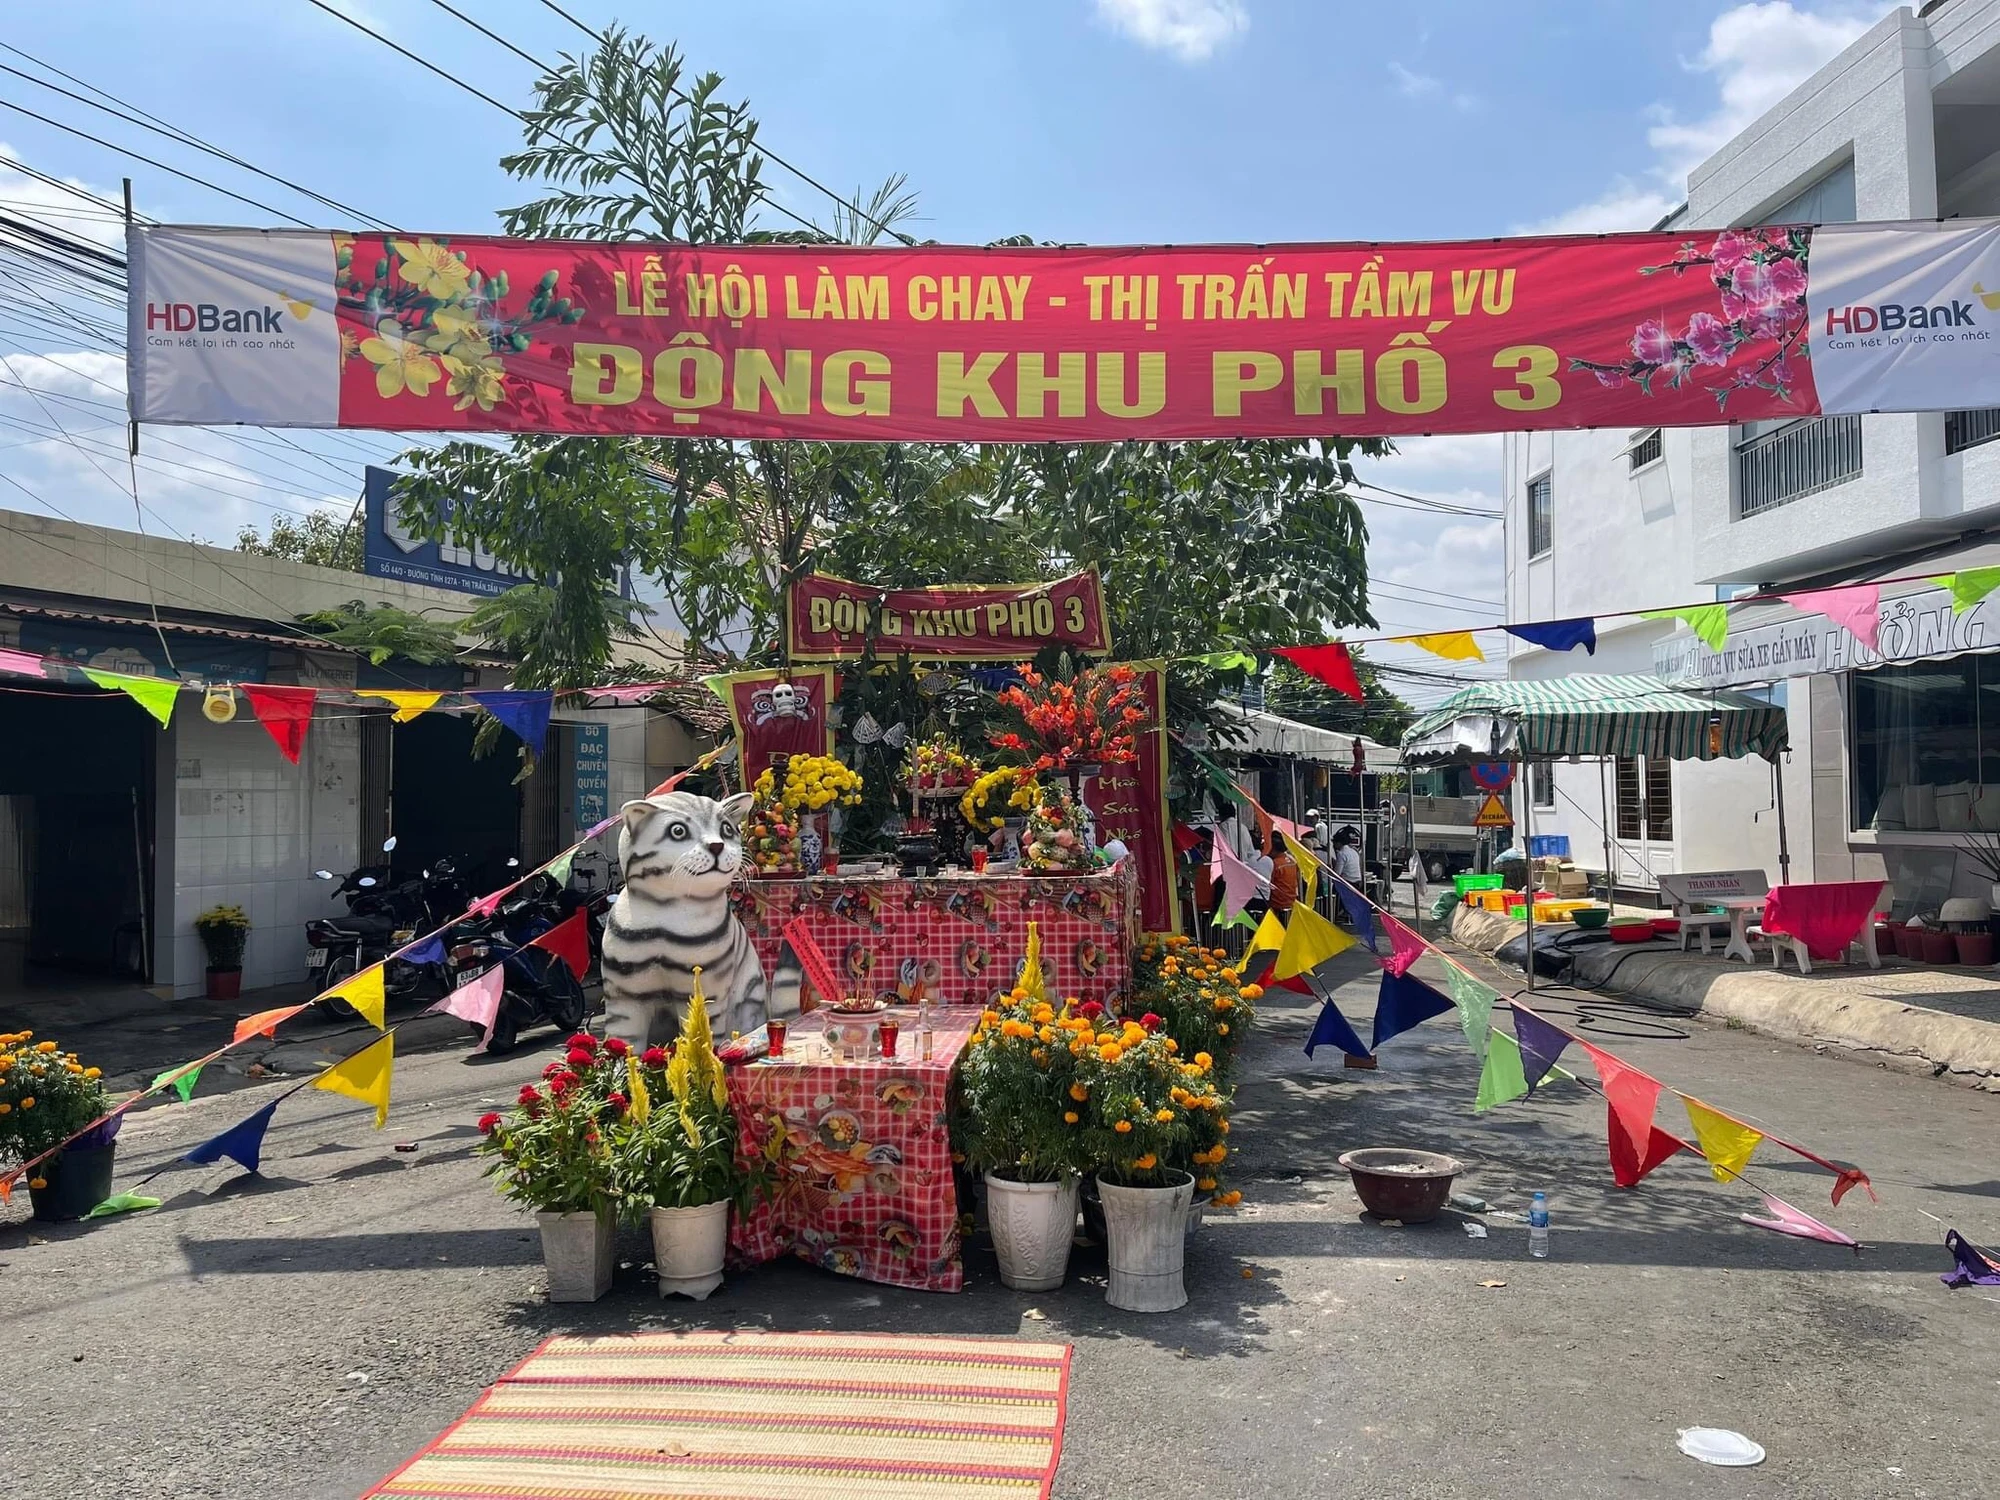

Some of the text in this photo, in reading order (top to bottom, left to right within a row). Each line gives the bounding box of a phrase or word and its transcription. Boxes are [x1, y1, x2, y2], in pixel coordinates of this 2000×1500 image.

[614, 255, 1517, 331] LỄ HỘI LÀM CHAY - THỊ TRẤN TẦM VU
[147, 302, 284, 334] HDBank
[1826, 300, 1976, 336] HDBank
[243, 340, 264, 349] cao
[1828, 339, 1855, 350] Cam
[1932, 333, 1955, 342] cao
[567, 320, 1562, 424] ĐỘNG KHU PHỐ 3
[910, 608, 978, 637] KHU
[1065, 595, 1085, 634] 3
[1738, 638, 1755, 671] SỬA
[1757, 644, 1770, 668] XE
[1772, 627, 1792, 665] GẮN
[1794, 628, 1817, 661] MÁY
